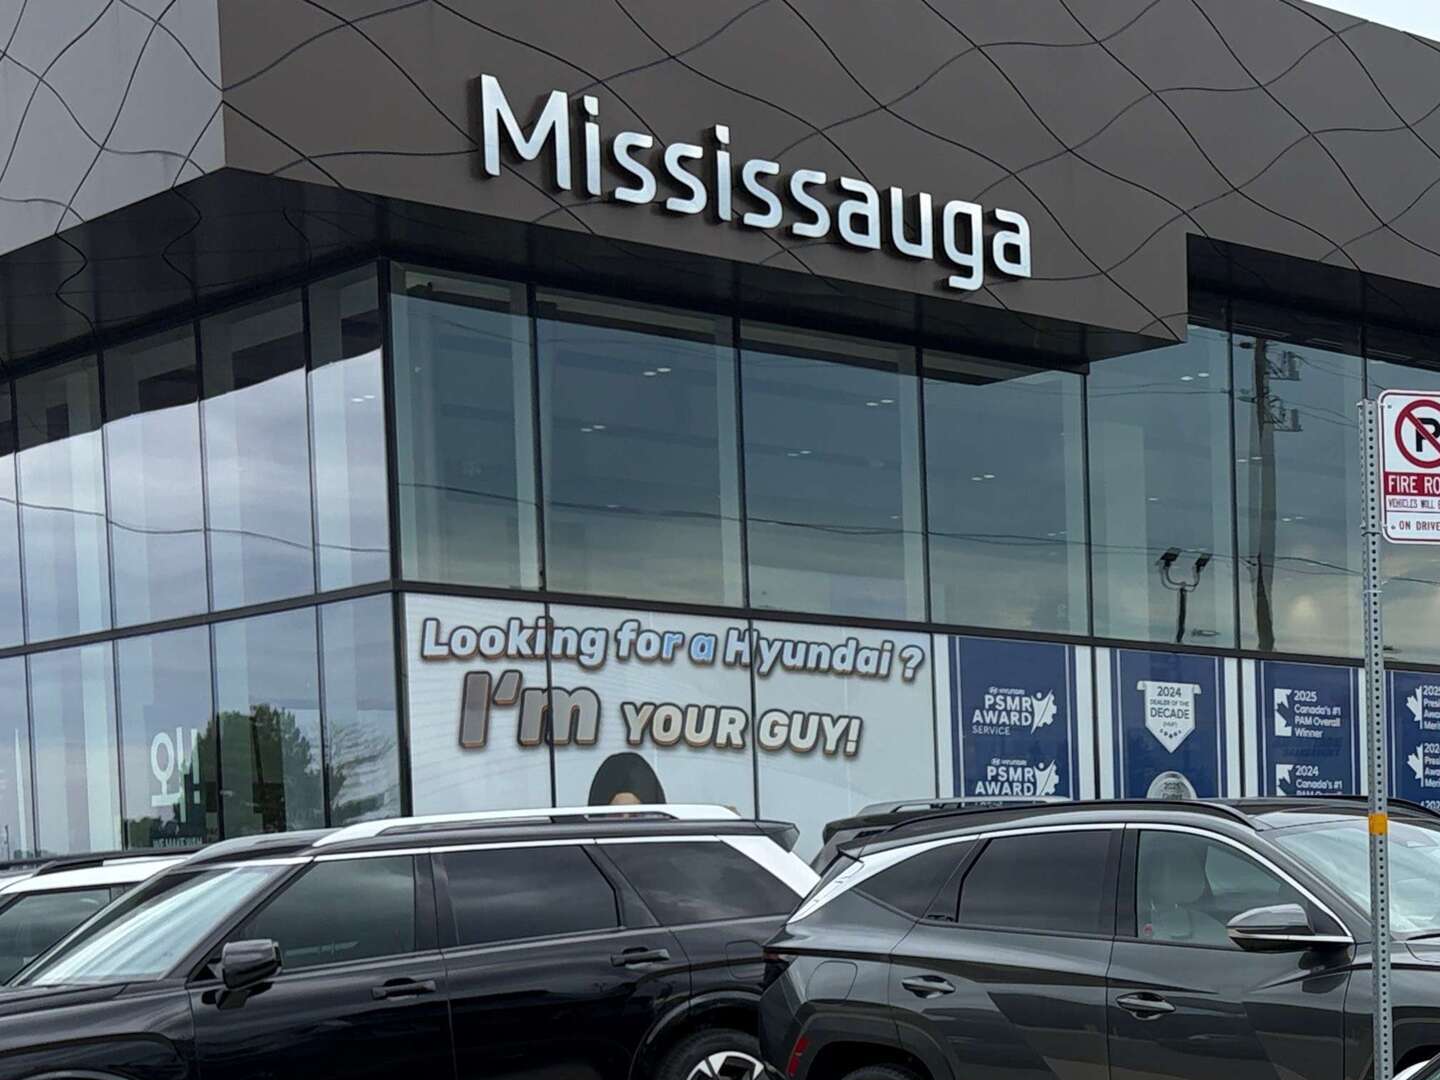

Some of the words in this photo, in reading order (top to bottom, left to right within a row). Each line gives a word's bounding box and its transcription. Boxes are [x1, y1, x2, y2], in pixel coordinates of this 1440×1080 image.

[479, 73, 1032, 291] Mississauga
[1388, 475, 1418, 493] FIRE
[1388, 498, 1418, 508] VEHICLES
[1421, 499, 1435, 509] WILL
[1399, 520, 1411, 530] ON
[421, 617, 608, 673] Looking
[614, 619, 682, 660] for
[689, 633, 717, 664] a
[1157, 686, 1182, 697] 2024
[1294, 690, 1318, 702] 2025
[984, 694, 1032, 711] PSMR
[458, 669, 601, 748] I'm
[621, 700, 748, 750] YOUR
[757, 708, 864, 756] GUY!
[1150, 707, 1190, 719] DECADE
[1294, 704, 1331, 715] Canada's
[972, 709, 1032, 726] AWARD
[1294, 716, 1312, 726] PAM
[1313, 717, 1341, 727] Overall
[972, 725, 1011, 735] SERVICE
[1294, 728, 1323, 738] Winner
[986, 765, 1034, 782] PSMR
[1295, 765, 1319, 776] 2024
[975, 780, 1034, 797] AWARD
[1295, 779, 1332, 790] Canada's
